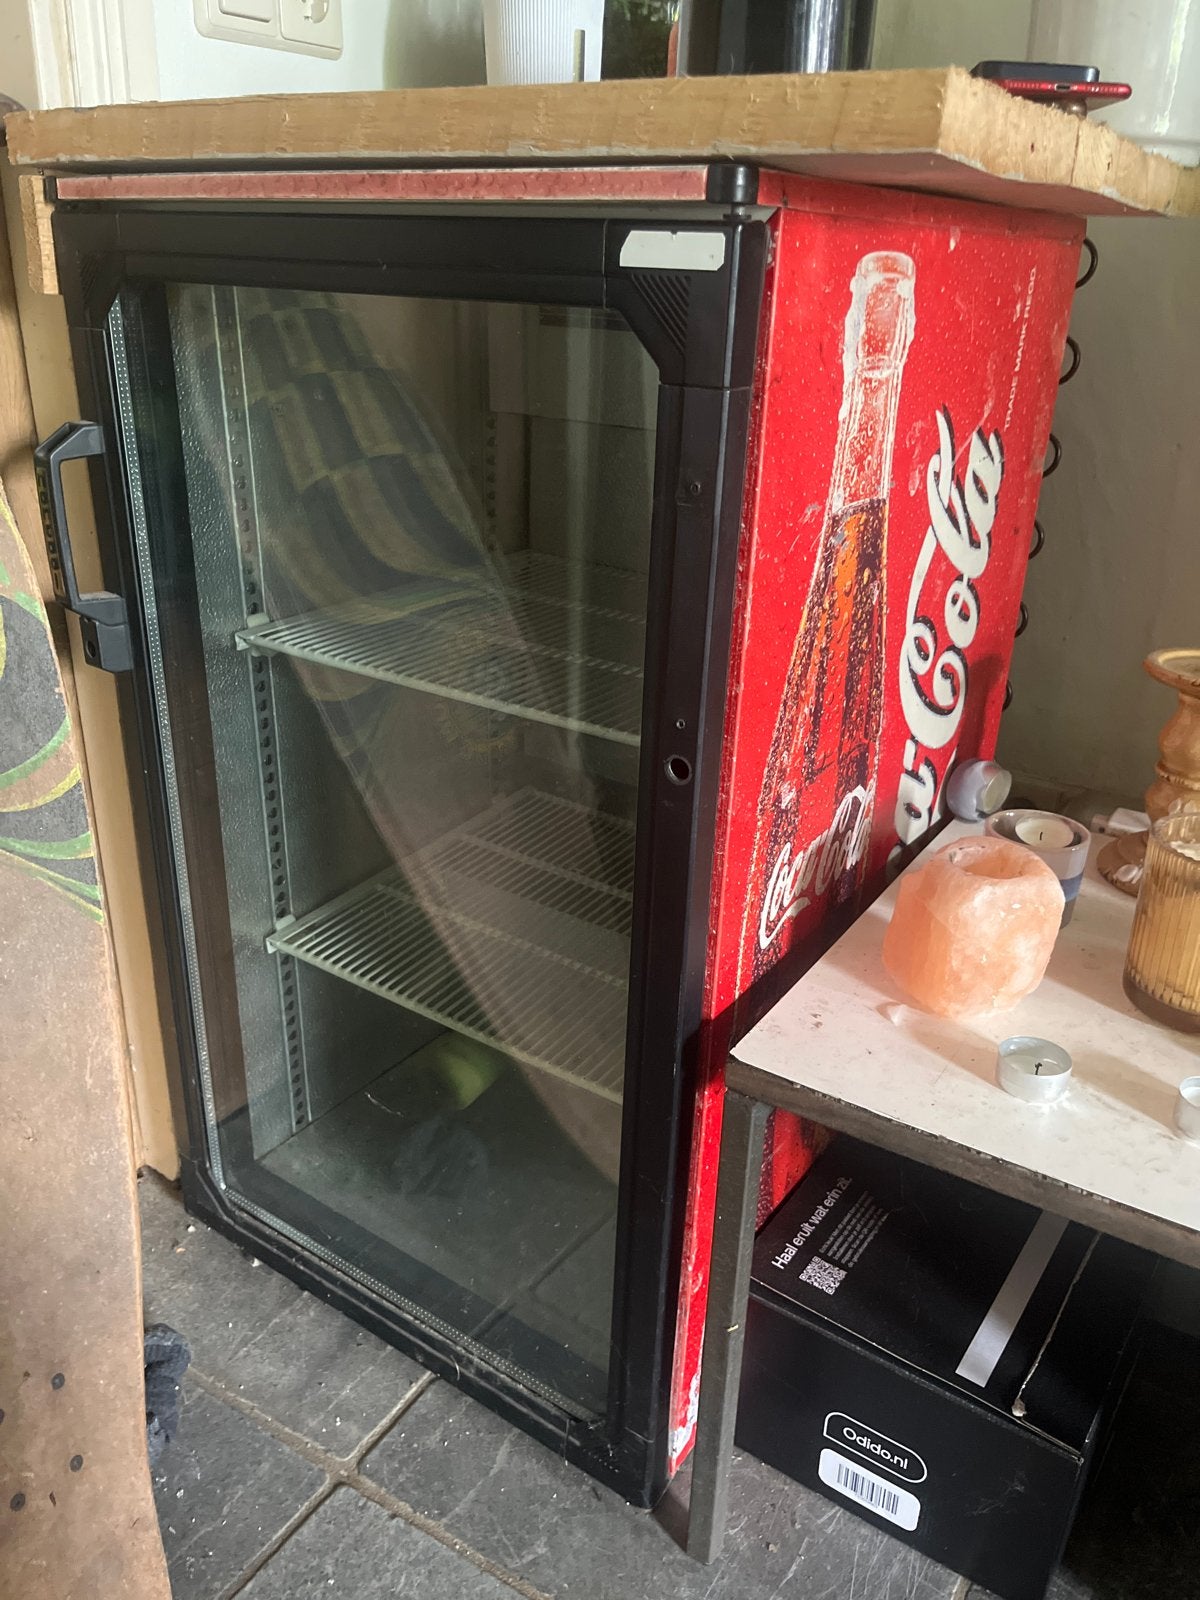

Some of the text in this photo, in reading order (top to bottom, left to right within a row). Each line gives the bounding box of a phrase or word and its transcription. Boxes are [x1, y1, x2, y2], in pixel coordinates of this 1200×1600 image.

[1003, 376, 1019, 432] TRADE
[1014, 321, 1028, 372] MARK
[771, 1243, 798, 1270] Haal
[792, 1222, 816, 1247] eruit
[808, 1205, 830, 1225] wat
[843, 1427, 908, 1469] Odido.nl
